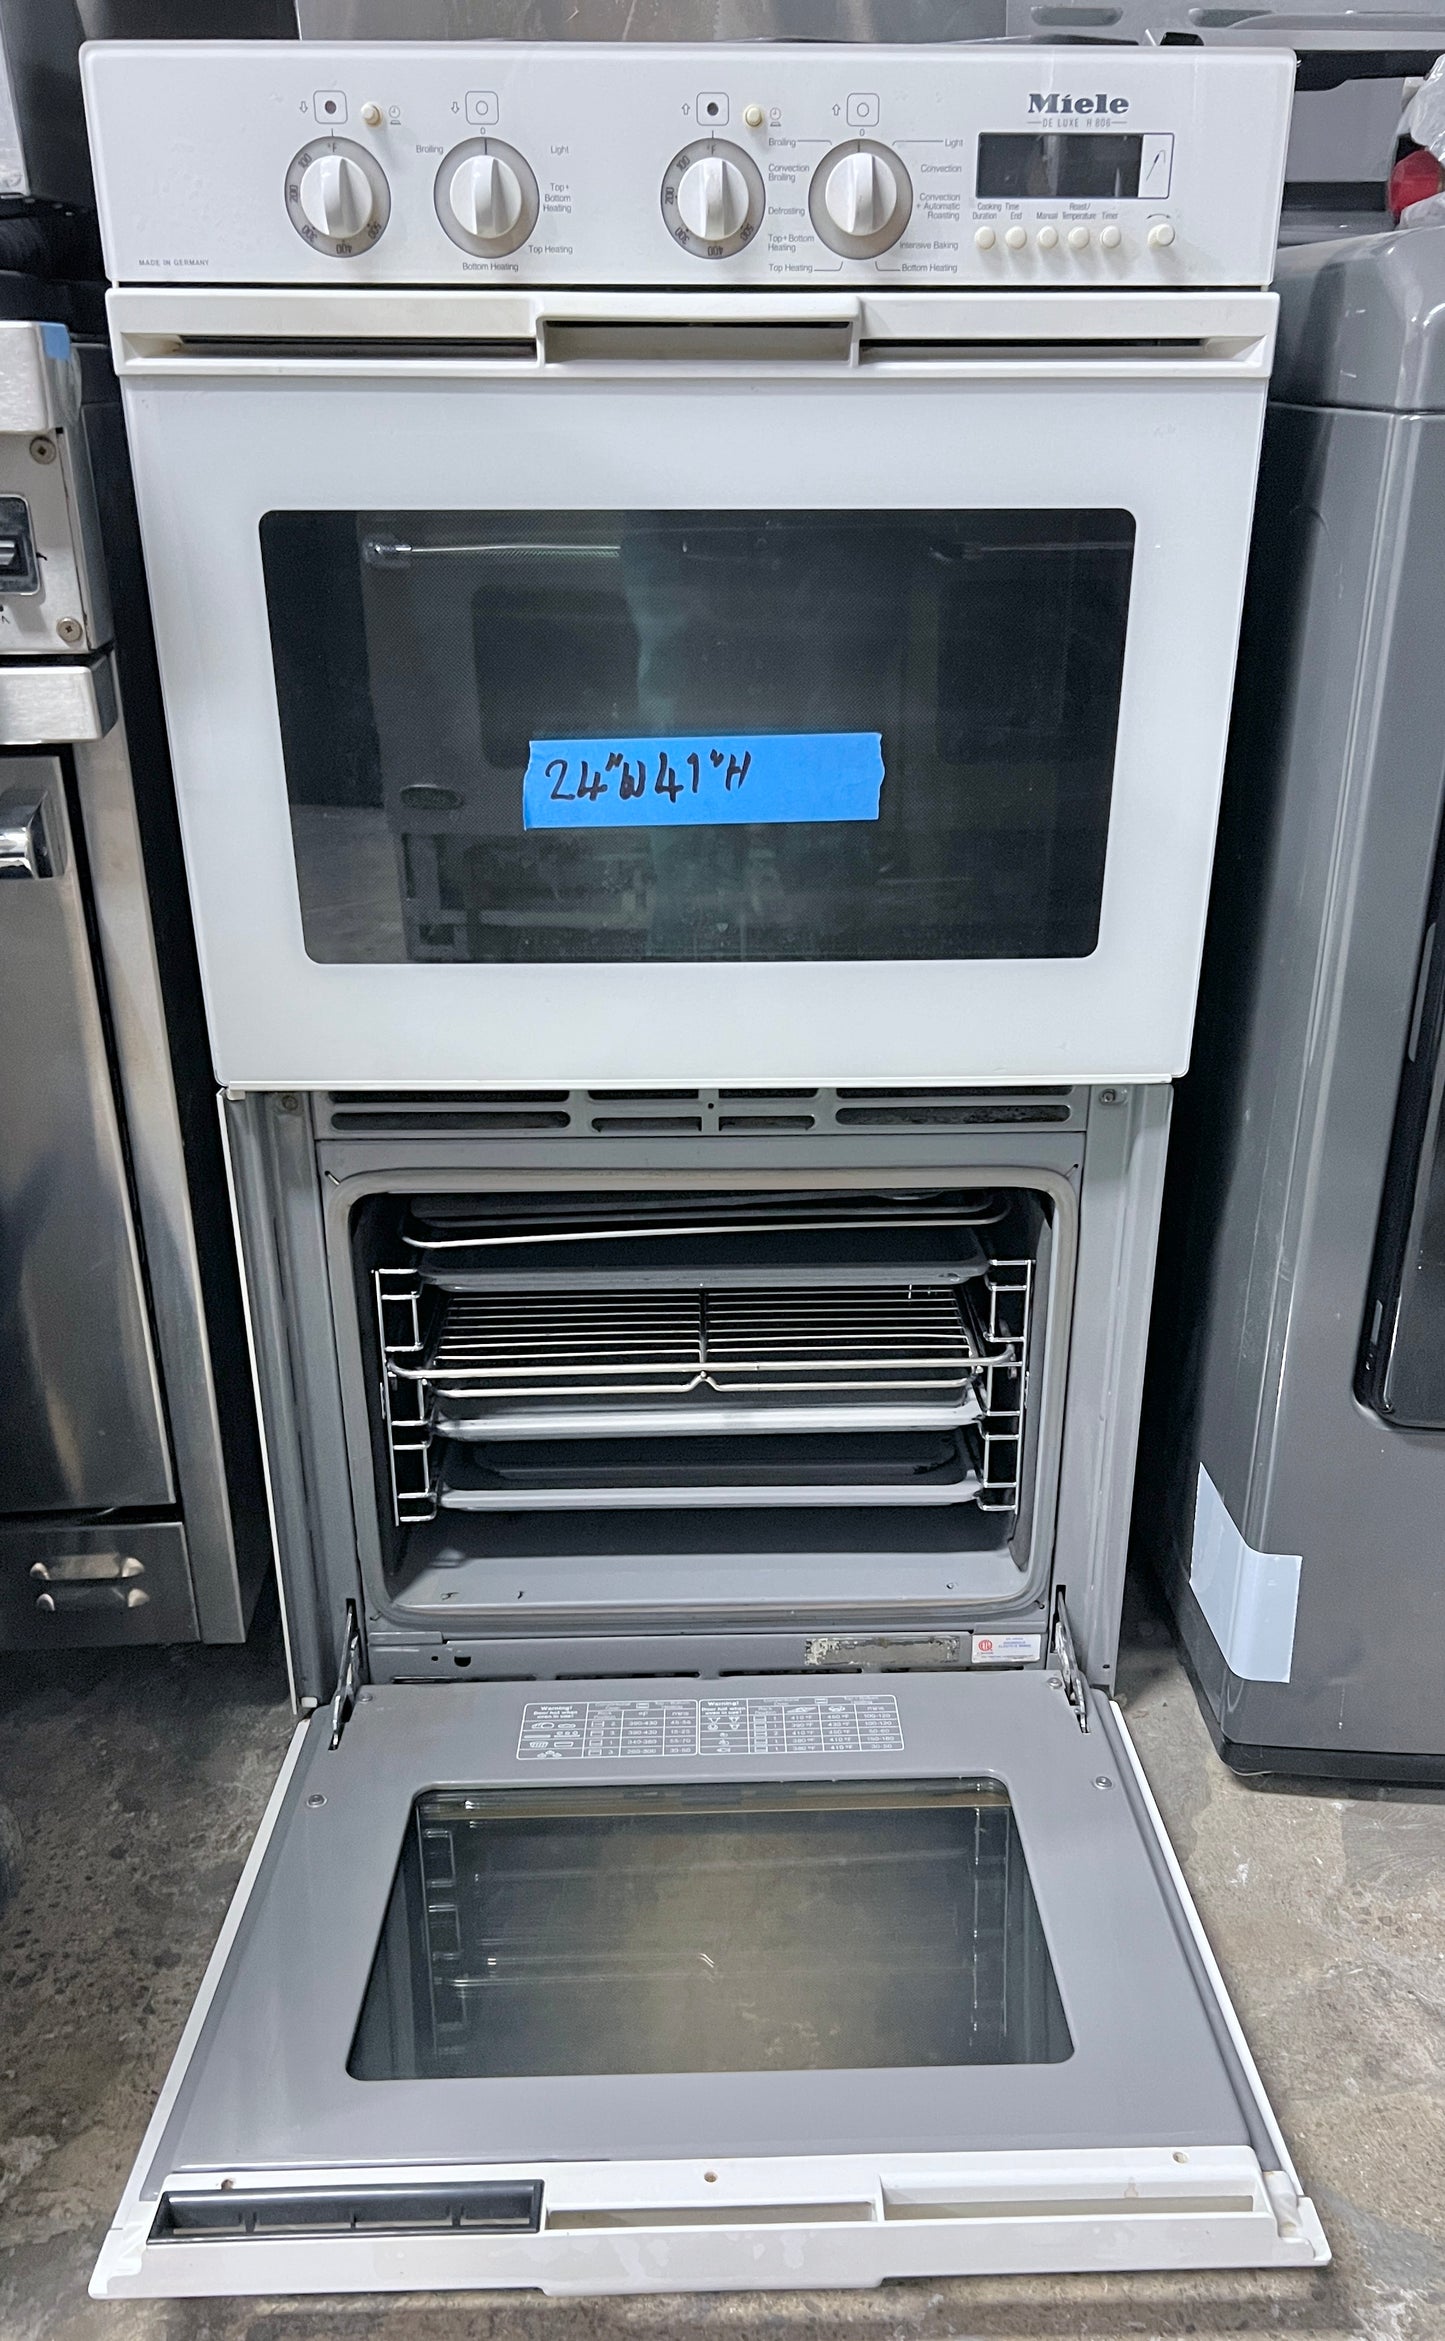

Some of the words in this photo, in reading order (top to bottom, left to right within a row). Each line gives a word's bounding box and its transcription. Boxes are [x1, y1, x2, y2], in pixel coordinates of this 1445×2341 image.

[1028, 93, 1129, 114] Miele
[1042, 118, 1053, 127] DE
[1057, 118, 1079, 127] LUXE
[1086, 118, 1092, 127] H
[768, 138, 797, 148] Broiling
[945, 138, 964, 149] Light
[416, 145, 444, 155] Broiling
[551, 145, 569, 156] Light
[768, 164, 810, 173] Convection
[920, 164, 962, 173] Convection
[768, 173, 796, 183] Broiling
[550, 183, 564, 193] Top
[289, 184, 299, 204] 200
[544, 193, 571, 203] Bottom
[665, 187, 675, 206] 200
[920, 192, 960, 201] Convection
[543, 204, 572, 214] Heating
[923, 202, 960, 210] Automatic
[977, 202, 1002, 212] Cooking
[1005, 202, 1019, 210] Time
[768, 206, 805, 217] Defrosting
[927, 211, 960, 222] Roasting
[972, 212, 997, 220] Duration
[1010, 212, 1022, 220] End
[1062, 212, 1096, 221] Temperature
[768, 234, 782, 244] Top
[788, 234, 814, 243] Bottom
[336, 244, 353, 254] 400
[528, 245, 543, 255] Top
[544, 245, 573, 255] Heating
[768, 243, 796, 253] Heating
[900, 241, 932, 250] Intensive
[933, 241, 959, 251] Baking
[707, 246, 724, 257] 400
[462, 262, 489, 272] Bottom
[490, 262, 519, 273] Heating
[769, 264, 783, 274] Top
[784, 264, 813, 274] Heating
[902, 264, 928, 272] Bottom
[929, 264, 958, 273] Heating
